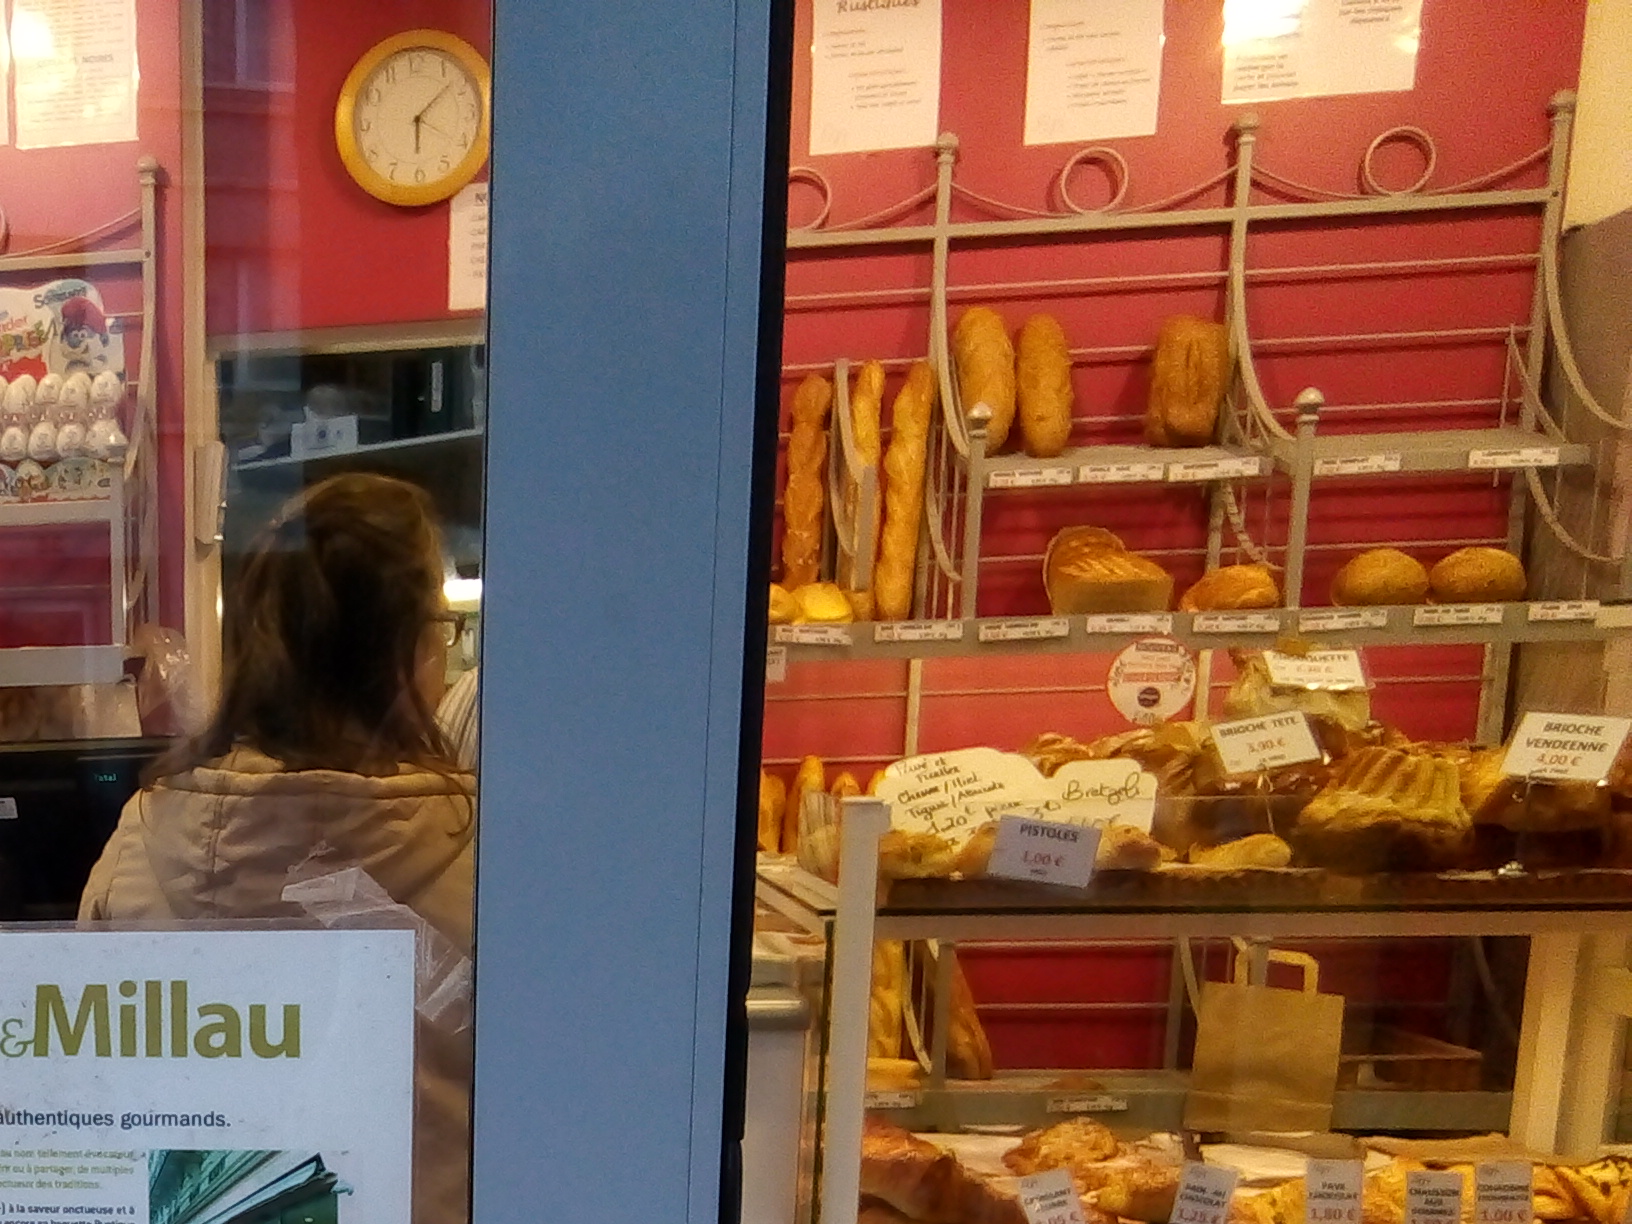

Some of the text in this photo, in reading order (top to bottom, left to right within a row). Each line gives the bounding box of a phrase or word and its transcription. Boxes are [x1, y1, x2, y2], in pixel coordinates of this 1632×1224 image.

[1218, 721, 1266, 739] BRIOCHE
[1543, 721, 1605, 736] BRIOCHE
[1526, 737, 1609, 752] VENDEENNE
[1020, 824, 1079, 844] PISTOLES
[120, 1107, 232, 1131] gourmands.
